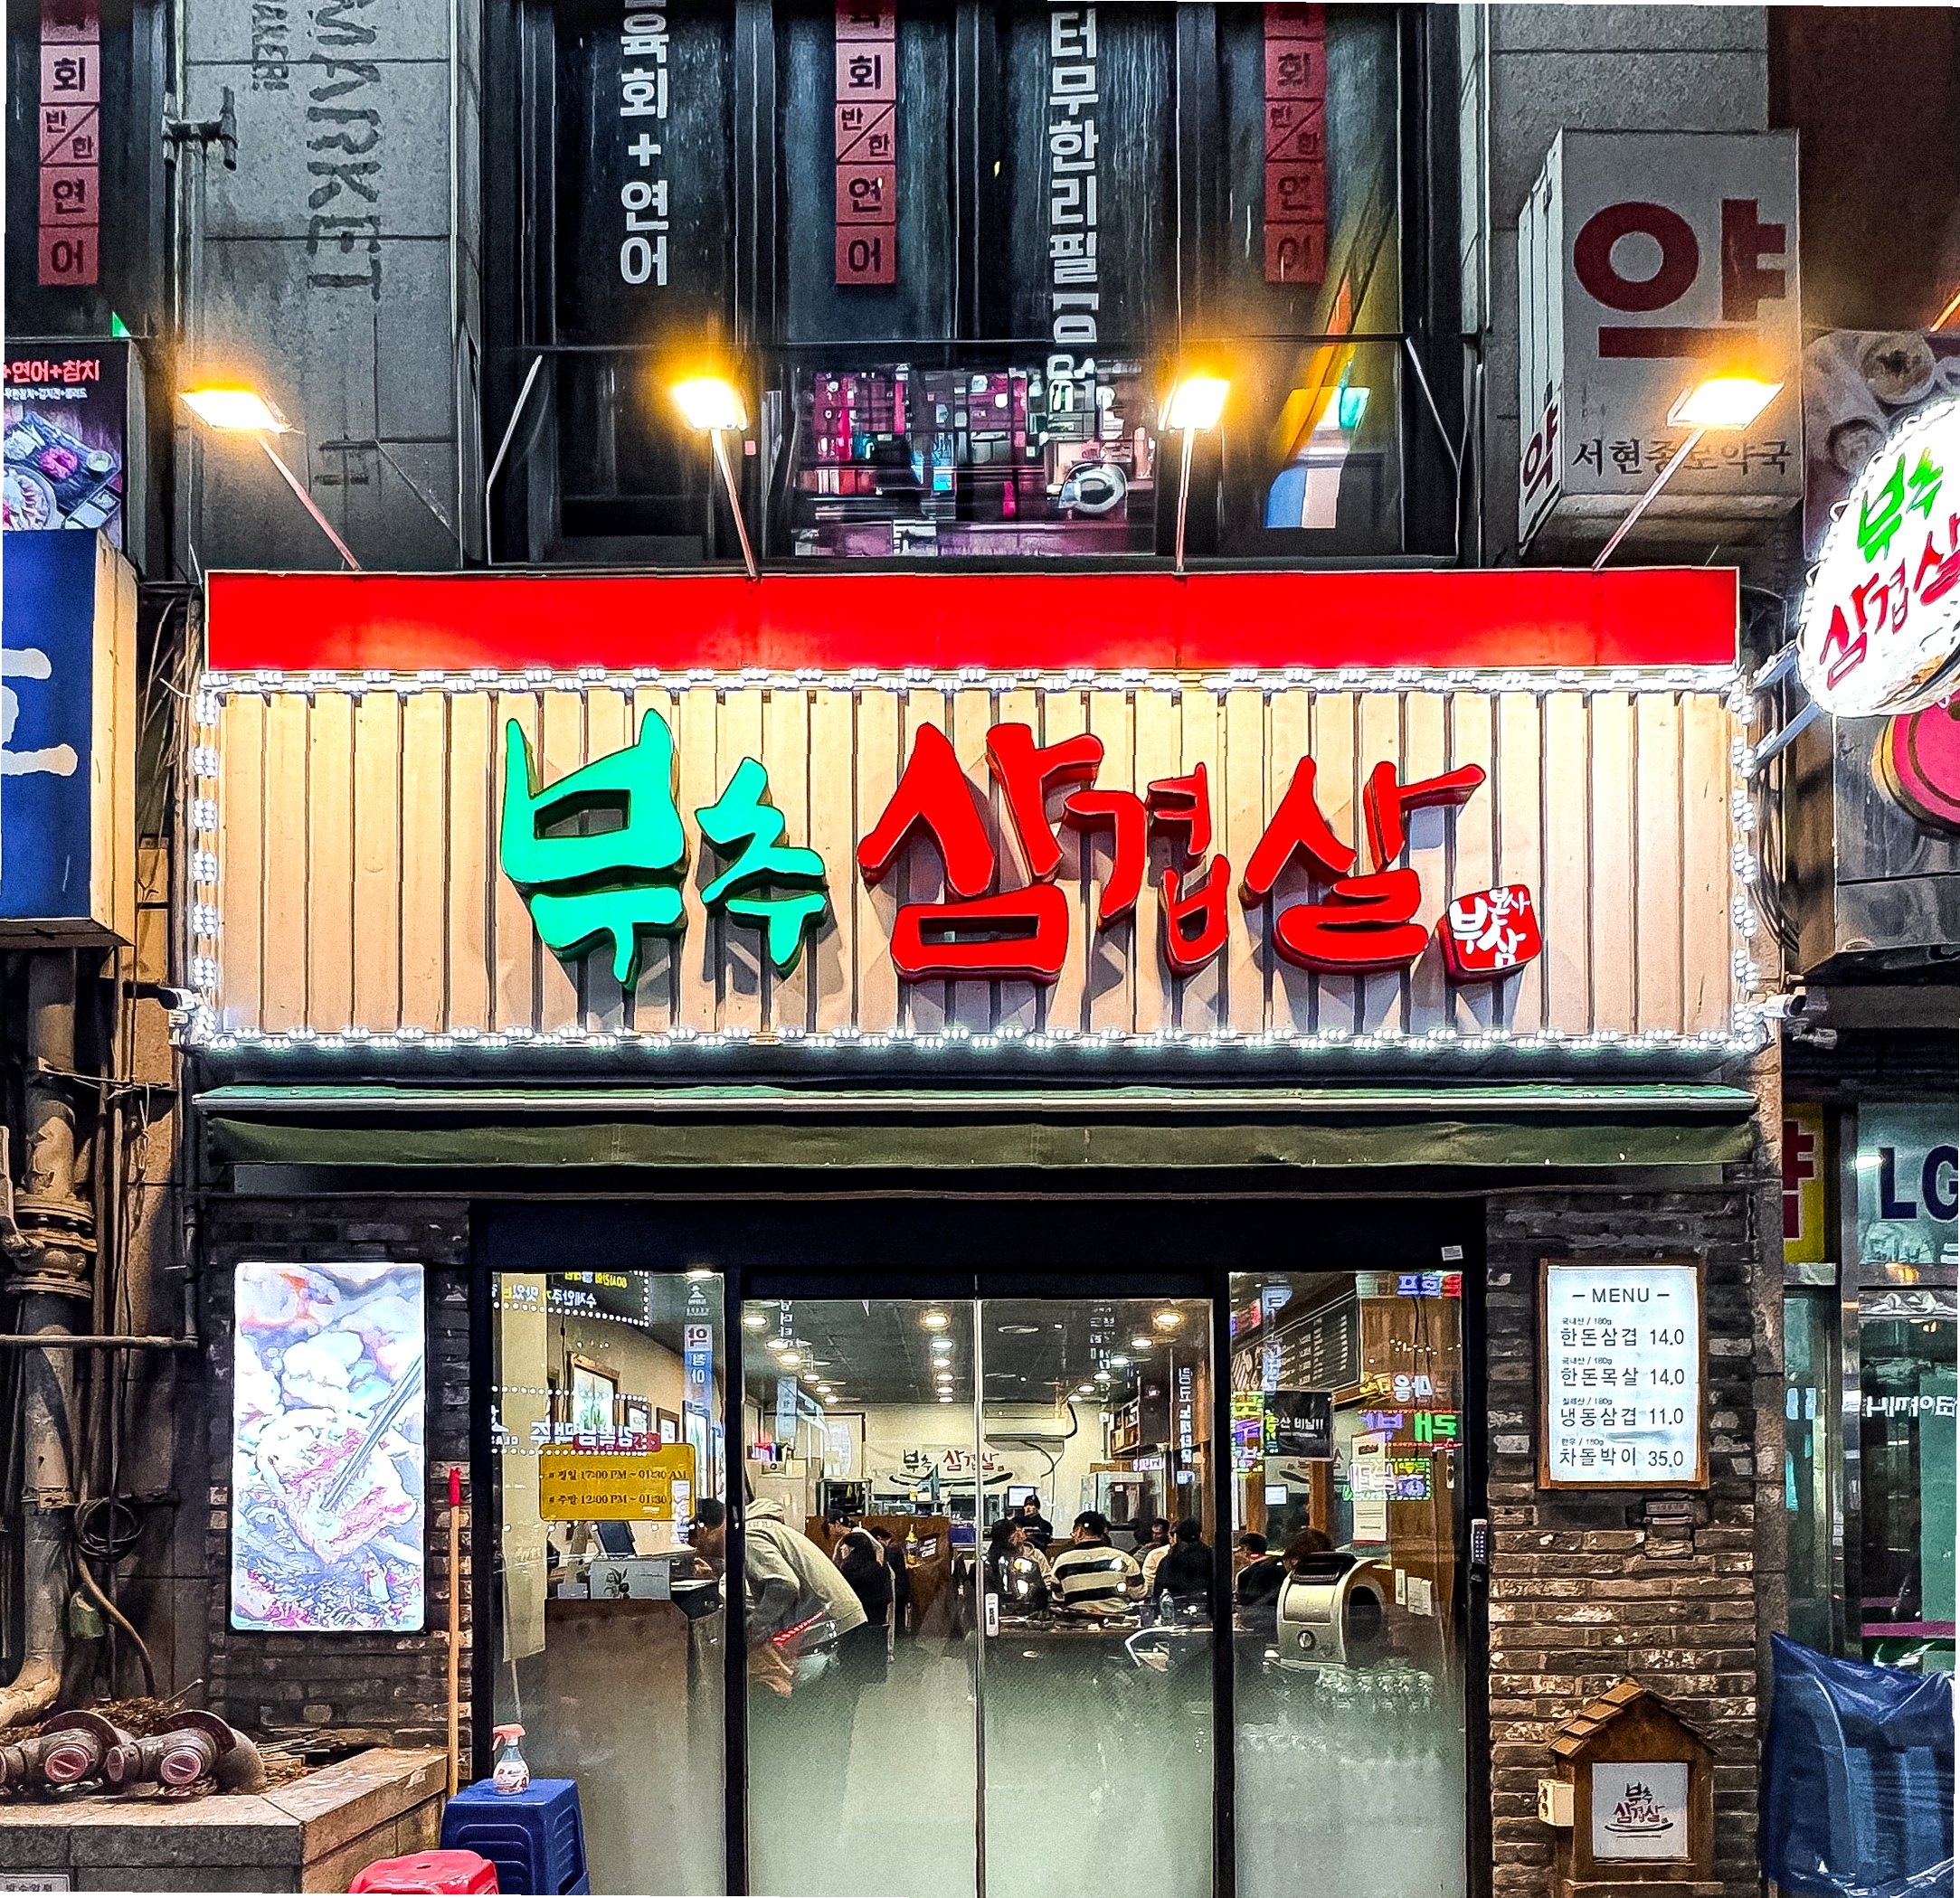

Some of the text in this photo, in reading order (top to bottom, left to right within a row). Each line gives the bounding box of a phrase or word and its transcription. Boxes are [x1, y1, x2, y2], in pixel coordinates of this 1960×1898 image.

[1573, 198, 1786, 360] 약
[1522, 403, 1558, 505] 약
[1857, 446, 1944, 563] 부추
[500, 707, 1486, 989] 부추 삼겹살
[1592, 1288, 1650, 1303] MENU
[1562, 1317, 1585, 1326] 국내산
[1560, 1327, 1685, 1347] 한돈삼겹 14.0
[1562, 1357, 1585, 1365] 국내산
[1560, 1367, 1685, 1387] 한돈목살 14.0
[1560, 1407, 1684, 1428] 냉동삼겹 11.0
[1559, 1447, 1684, 1468] 차돌박이 35.0
[611, 1470, 627, 1479] PM
[582, 1494, 608, 1504] 12:00
[611, 1495, 628, 1504] PM
[639, 1494, 667, 1505] 01:30
[1613, 1801, 1666, 1824] 삼겹살
